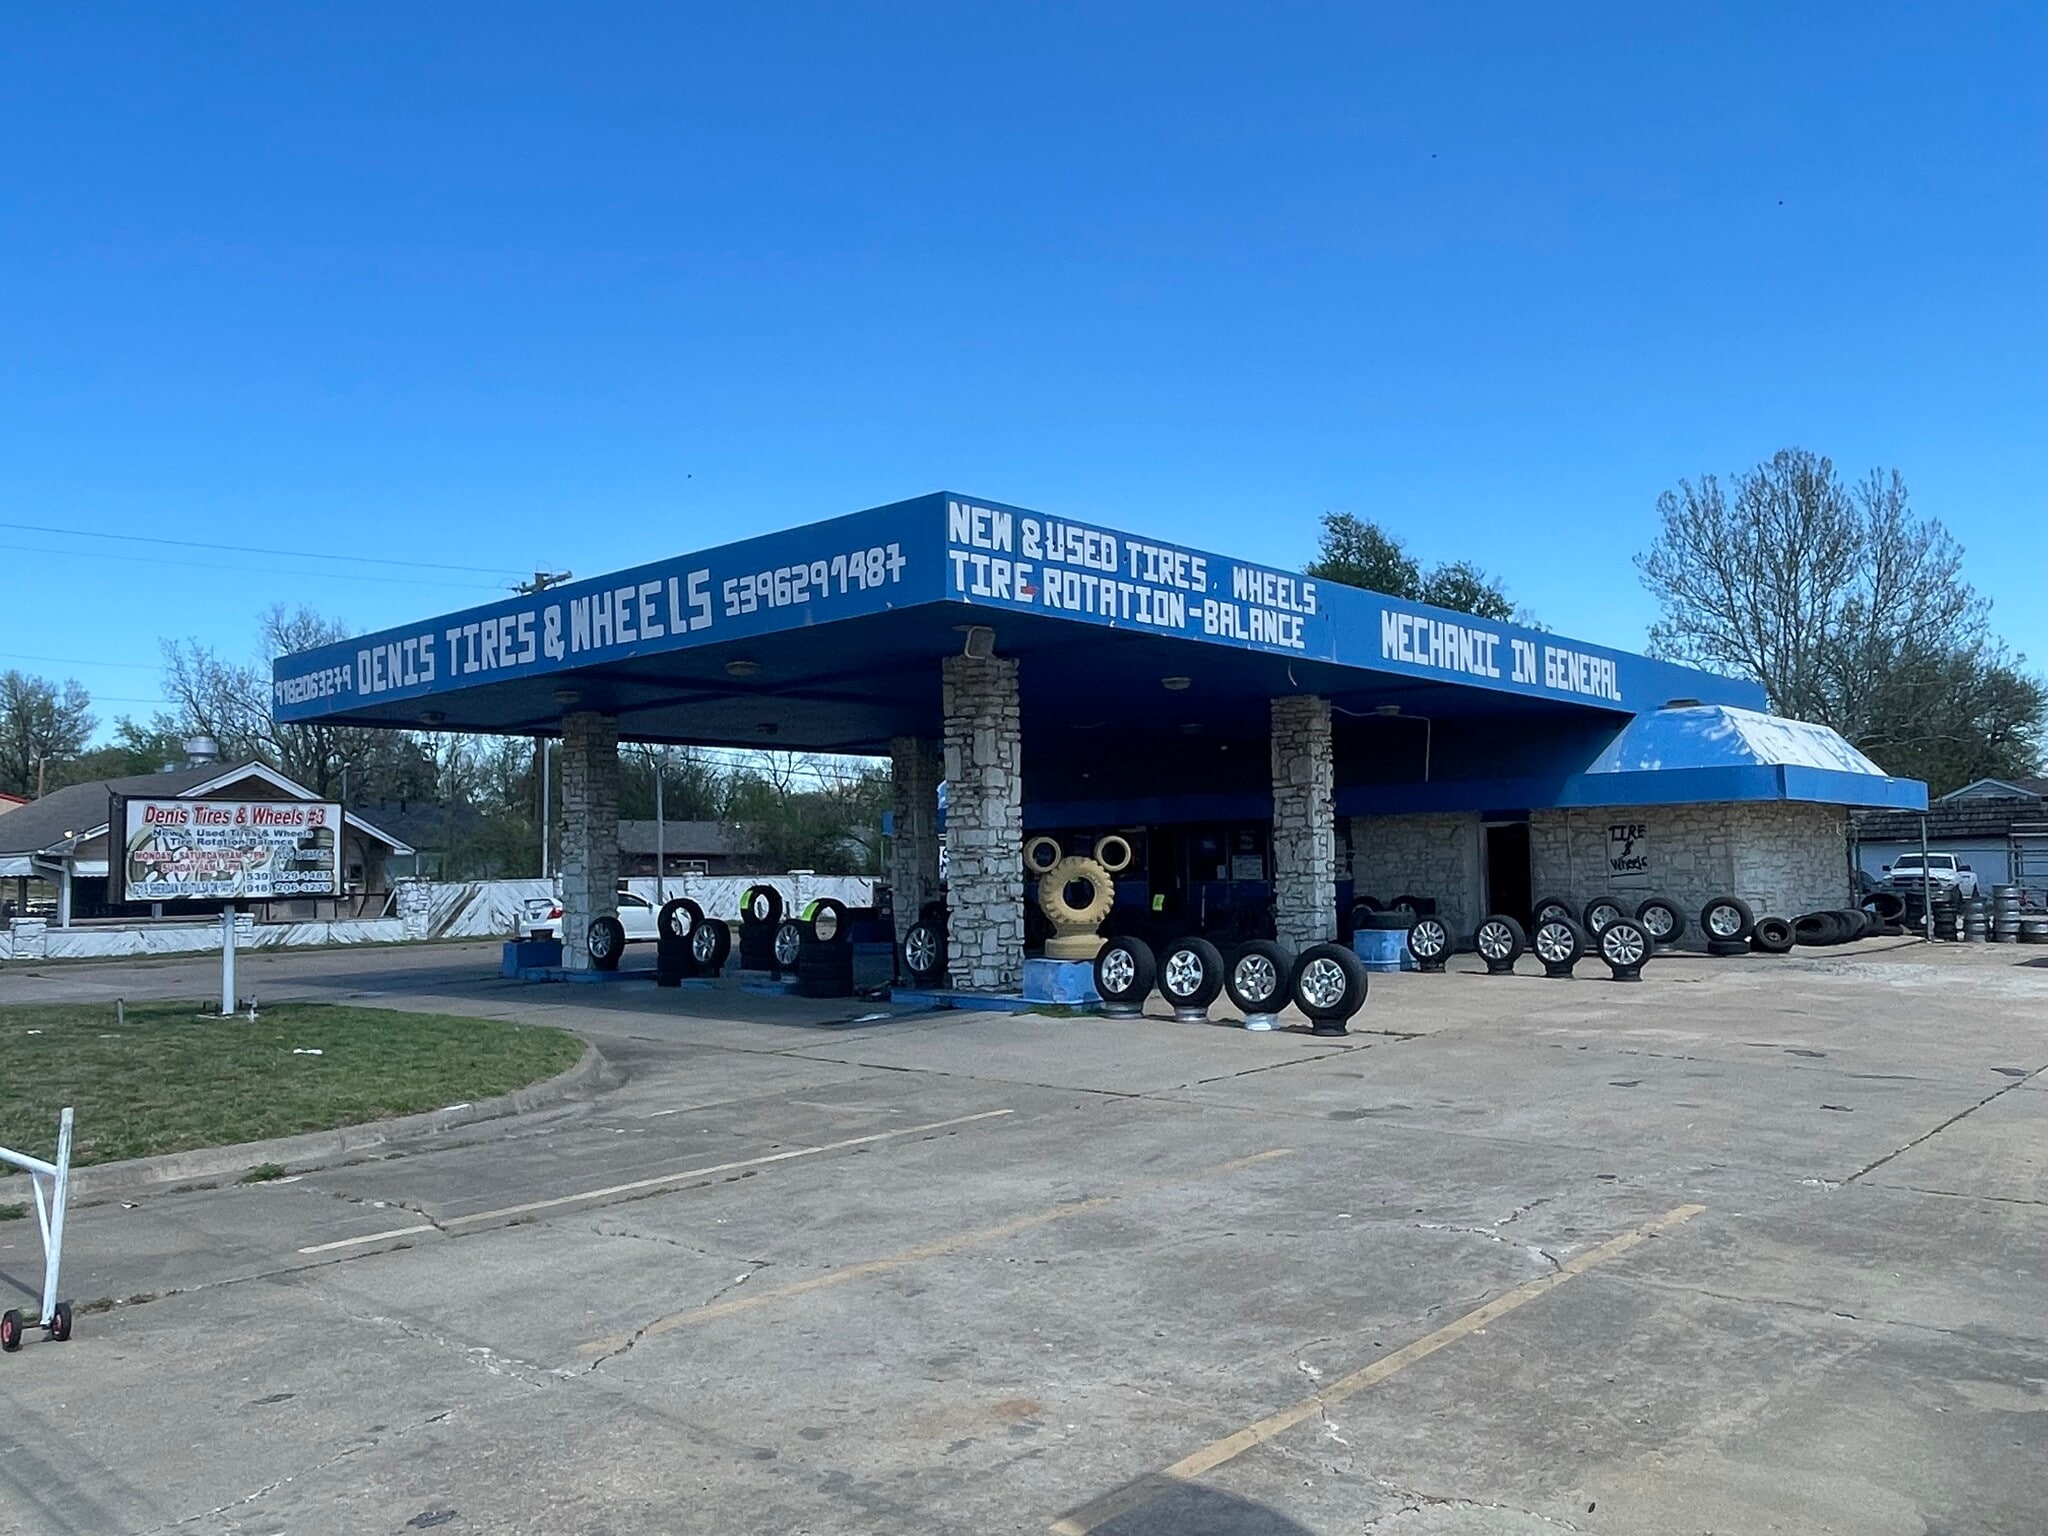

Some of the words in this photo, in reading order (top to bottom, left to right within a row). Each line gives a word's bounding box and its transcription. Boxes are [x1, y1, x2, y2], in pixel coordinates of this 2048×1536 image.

[948, 500, 1013, 554] NEW
[1045, 521, 1118, 573] USED
[1232, 566, 1316, 615] WHEELS
[948, 549, 1033, 603] TIRE
[357, 633, 435, 696] DENIS
[446, 609, 536, 677] TIRES
[542, 604, 566, 661] &
[569, 568, 713, 653] WHEELS
[723, 542, 907, 617] 5396291487
[1381, 609, 1501, 679] MECHANIC
[1511, 638, 1537, 685] IN
[1544, 645, 1622, 702] GENERAL
[143, 804, 189, 825] Denis
[193, 805, 231, 825] Tires
[235, 805, 246, 825] &
[252, 806, 304, 826] Wheels
[307, 807, 325, 826] #3
[153, 829, 177, 837] New
[184, 829, 192, 837] &
[196, 829, 225, 837] Used
[273, 829, 313, 838] Wheels
[1608, 824, 1647, 842] TIRE
[170, 837, 193, 846] Tire
[135, 851, 172, 860] MONDAY
[179, 851, 222, 860] SATURDAY
[161, 863, 195, 872] SUNDAY
[243, 872, 273, 883] (539)
[243, 884, 273, 894] (918)
[276, 883, 331, 893] 206-3279
